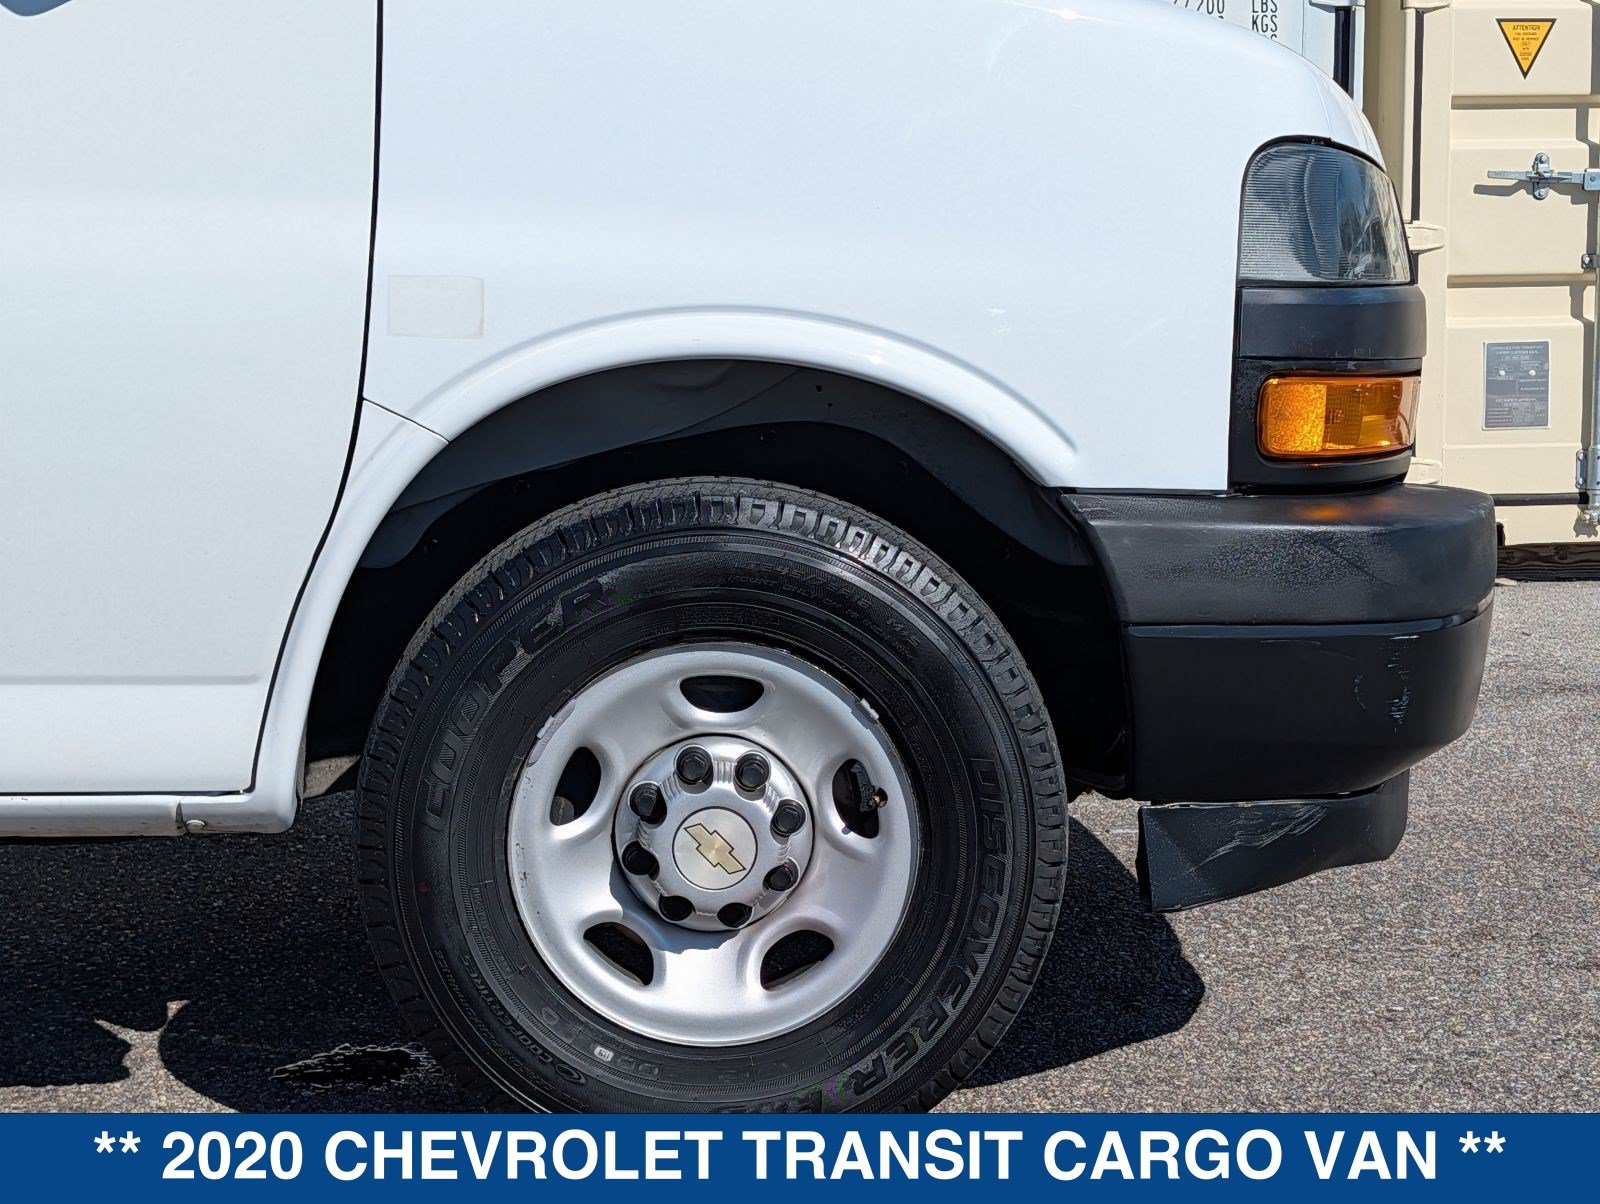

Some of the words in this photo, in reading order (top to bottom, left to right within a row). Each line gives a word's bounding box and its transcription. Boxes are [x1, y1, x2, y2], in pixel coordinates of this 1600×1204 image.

[1251, 15, 1278, 33] KGS
[418, 580, 608, 831] COOPER
[851, 757, 1006, 1096] DISCOVERER
